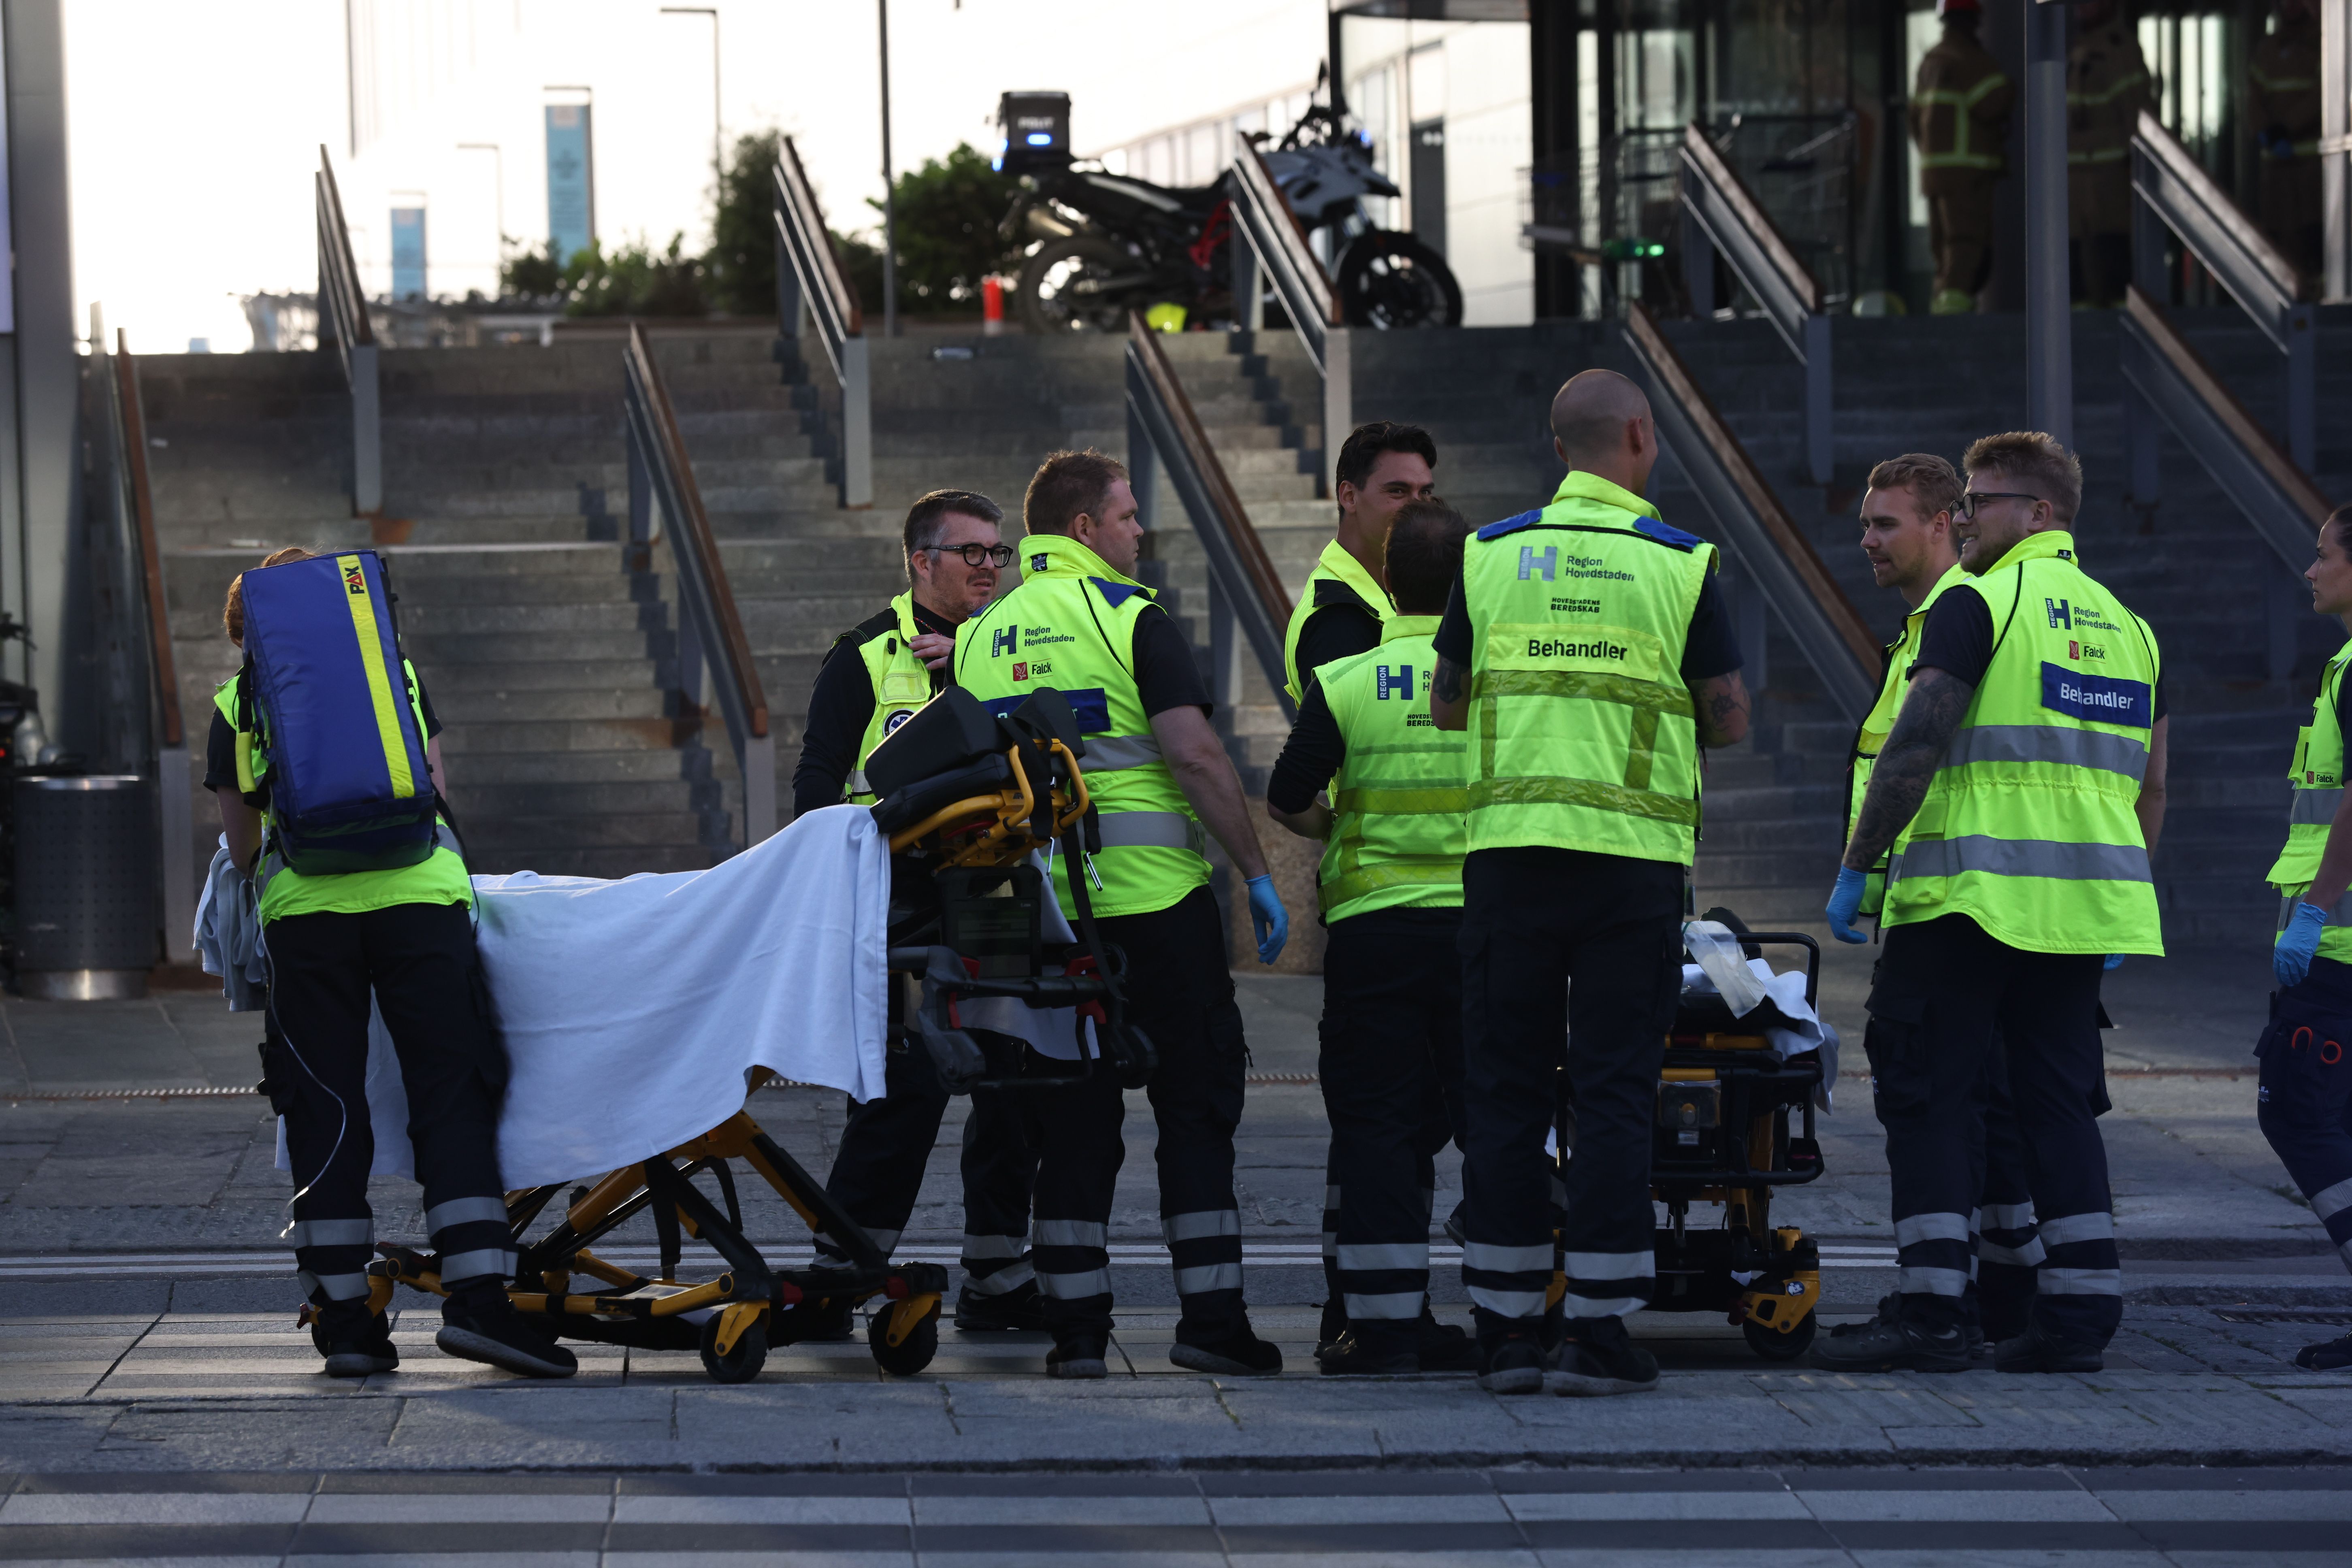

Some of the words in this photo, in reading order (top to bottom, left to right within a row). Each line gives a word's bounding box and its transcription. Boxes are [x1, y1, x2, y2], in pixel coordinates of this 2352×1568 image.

[1518, 546, 1557, 582] H
[1521, 548, 1530, 578] REGION
[1567, 555, 1602, 568] Region
[344, 566, 365, 594] PAX
[1566, 567, 1635, 582] Hovedstaden
[1551, 604, 1600, 613] BEREDSKAB
[1552, 597, 1600, 605] HOVEDSTADENS
[2045, 598, 2071, 630] H
[2046, 599, 2056, 627] REGION
[2074, 607, 2100, 618] Region
[1025, 626, 1051, 637] Region
[2075, 617, 2122, 634] Hovedstaden
[992, 624, 1017, 658] H
[1024, 634, 1075, 646] Hovedstaden
[1528, 639, 1628, 660] Behandler
[2084, 646, 2105, 660] Falck
[1031, 662, 1052, 675] Falck
[1376, 665, 1413, 700] H
[2061, 683, 2134, 709] Behandler
[2316, 774, 2334, 783] Falck
